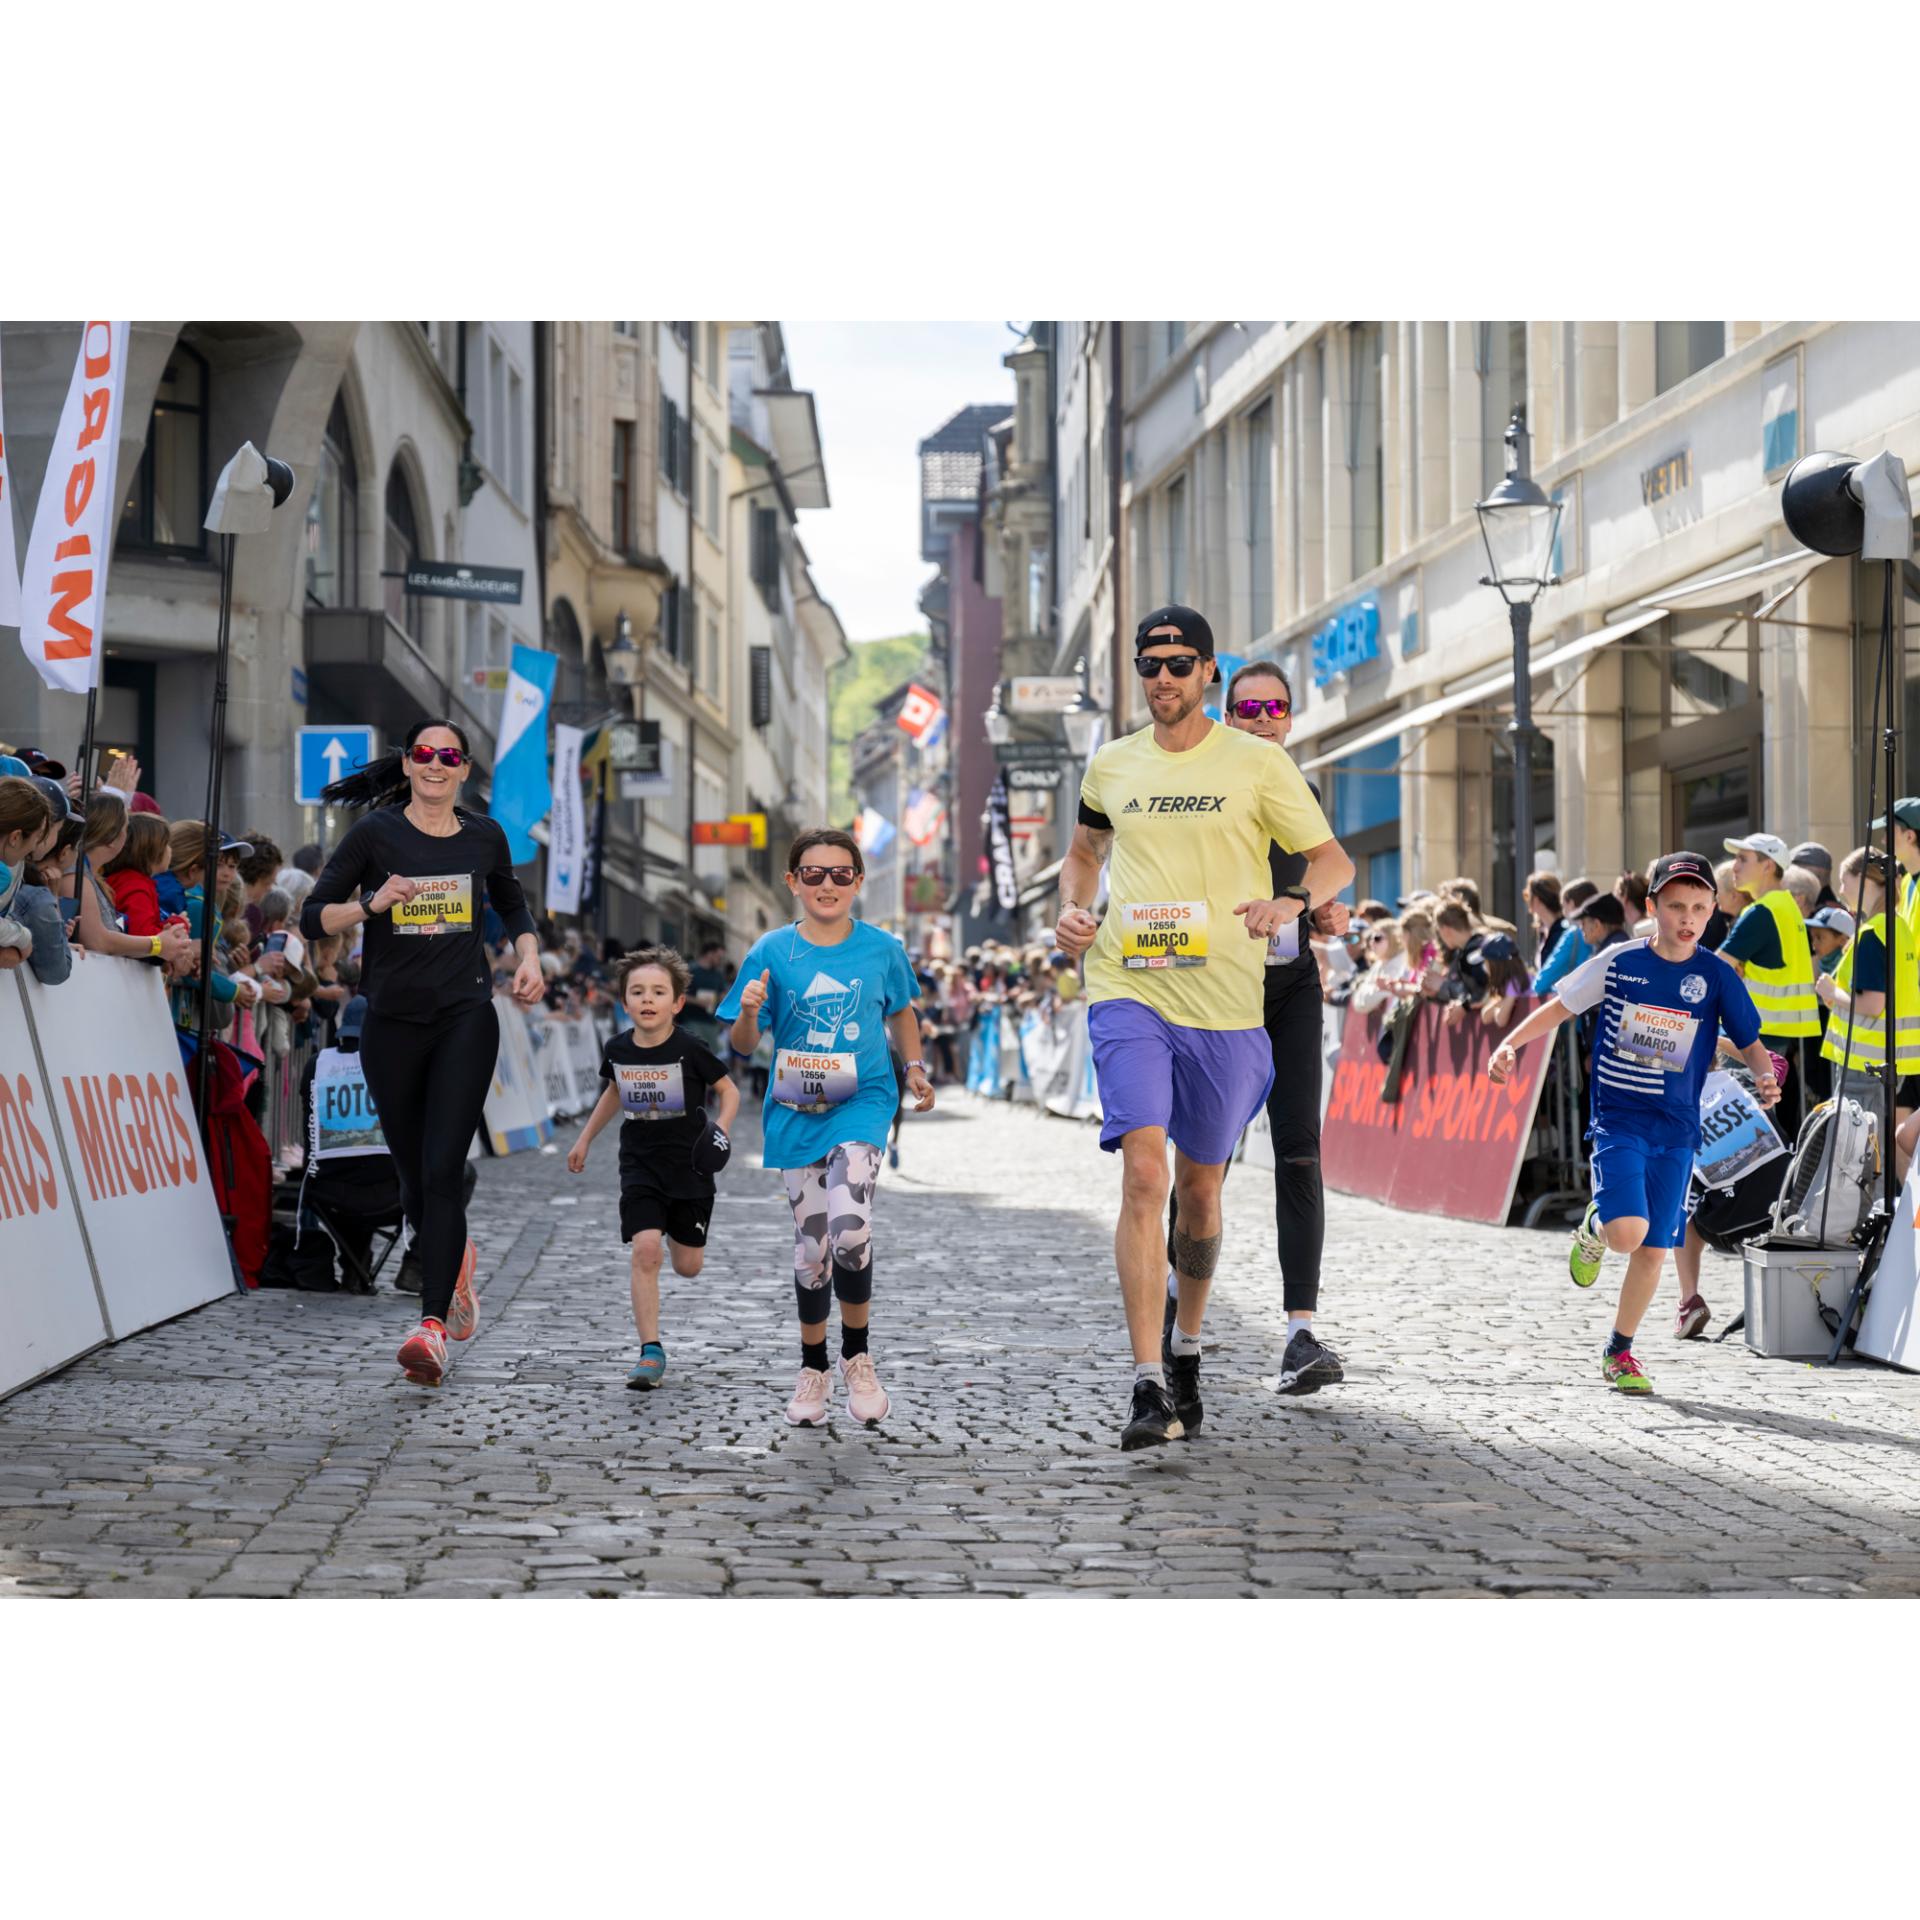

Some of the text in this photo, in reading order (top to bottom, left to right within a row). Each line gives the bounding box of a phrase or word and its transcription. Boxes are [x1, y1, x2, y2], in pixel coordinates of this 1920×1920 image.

[408, 573, 430, 587] LES
[1010, 770, 1060, 787] ONLY
[1148, 796, 1227, 812] TERREX
[416, 880, 459, 893] IGROS
[421, 893, 446, 901] 13080
[403, 902, 463, 916] CORNELIA
[1133, 907, 1191, 920] MIGROS
[1148, 921, 1176, 930] 12656
[1137, 932, 1188, 947] MARCO
[1618, 974, 1642, 983] CRAFT
[1634, 1011, 1686, 1032] MIGROS
[1646, 1026, 1669, 1037] 14455
[1631, 1032, 1677, 1053] MARCO
[787, 1056, 841, 1070] MIGROS
[621, 1071, 668, 1080] MIGROS
[800, 1070, 826, 1080] 12656
[803, 1082, 825, 1095] LIA
[628, 1091, 666, 1103] LEANO
[1412, 1071, 1531, 1142] SPORTX
[1696, 1098, 1753, 1156] RESSE
[61, 1071, 198, 1202] MIGROS
